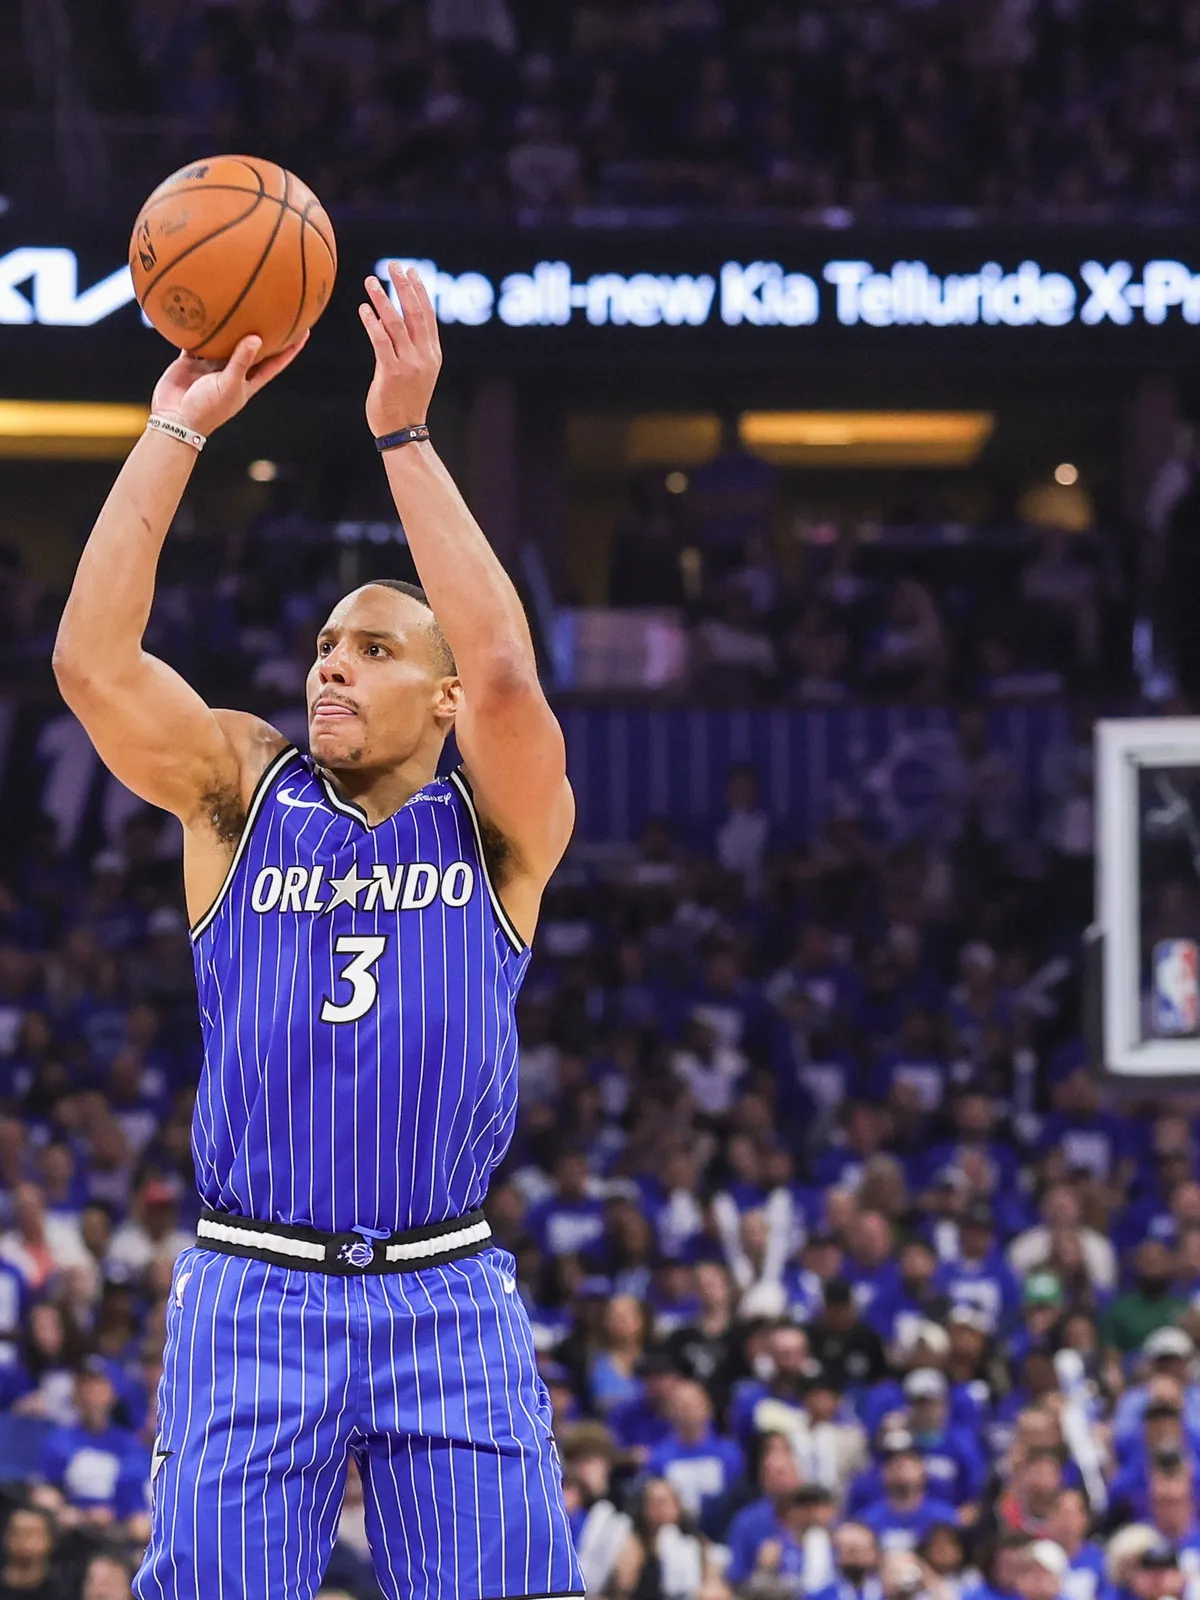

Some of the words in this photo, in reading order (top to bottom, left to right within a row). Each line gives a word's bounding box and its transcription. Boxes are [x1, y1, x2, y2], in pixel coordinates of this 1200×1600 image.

[498, 260, 715, 327] all-new
[720, 261, 819, 327] Kia
[823, 260, 1077, 327] Telluride
[161, 422, 187, 439] Never
[320, 933, 390, 1025] 3
